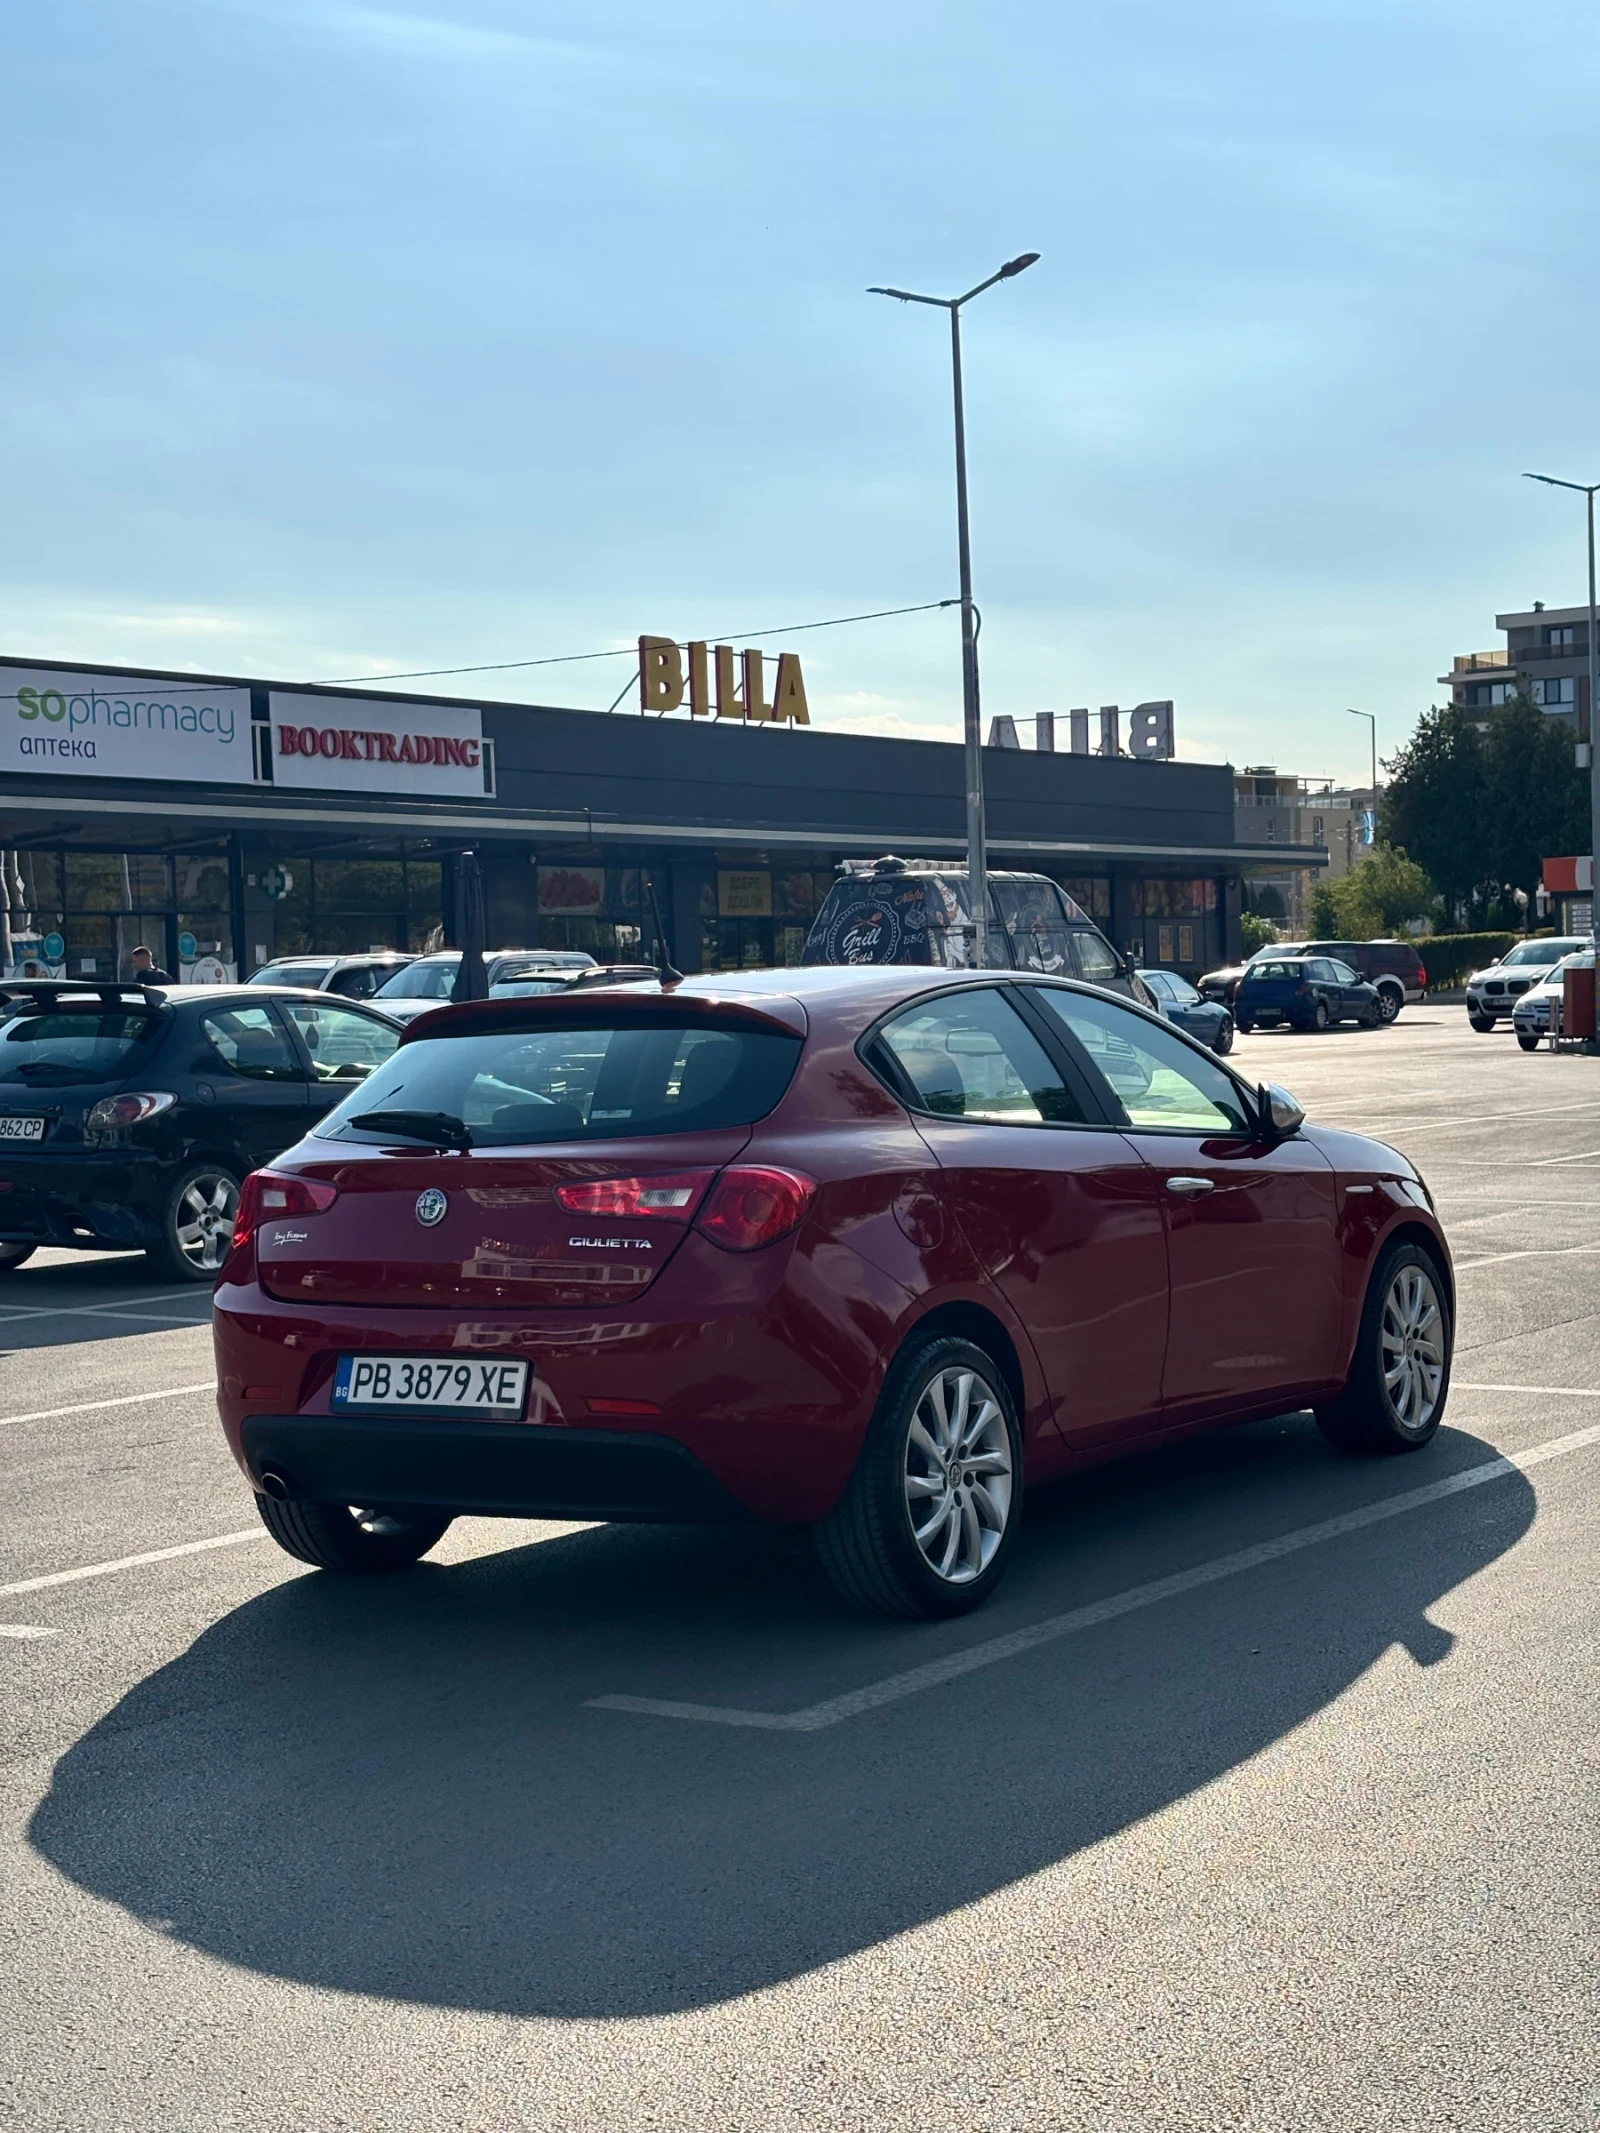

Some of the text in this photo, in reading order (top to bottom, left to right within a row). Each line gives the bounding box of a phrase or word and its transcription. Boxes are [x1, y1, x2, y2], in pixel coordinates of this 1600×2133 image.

[639, 635, 811, 725] BILLA
[20, 736, 97, 758] аптека
[278, 725, 480, 768] BOOKTRADING
[729, 876, 761, 891] ДОБРЕ
[842, 926, 882, 956] Grill
[903, 933, 925, 945] BBQ
[848, 947, 874, 965] Bus
[569, 1237, 652, 1248] GIULIETTA
[335, 1386, 348, 1397] BG
[352, 1363, 519, 1404] PB 3879 XE
